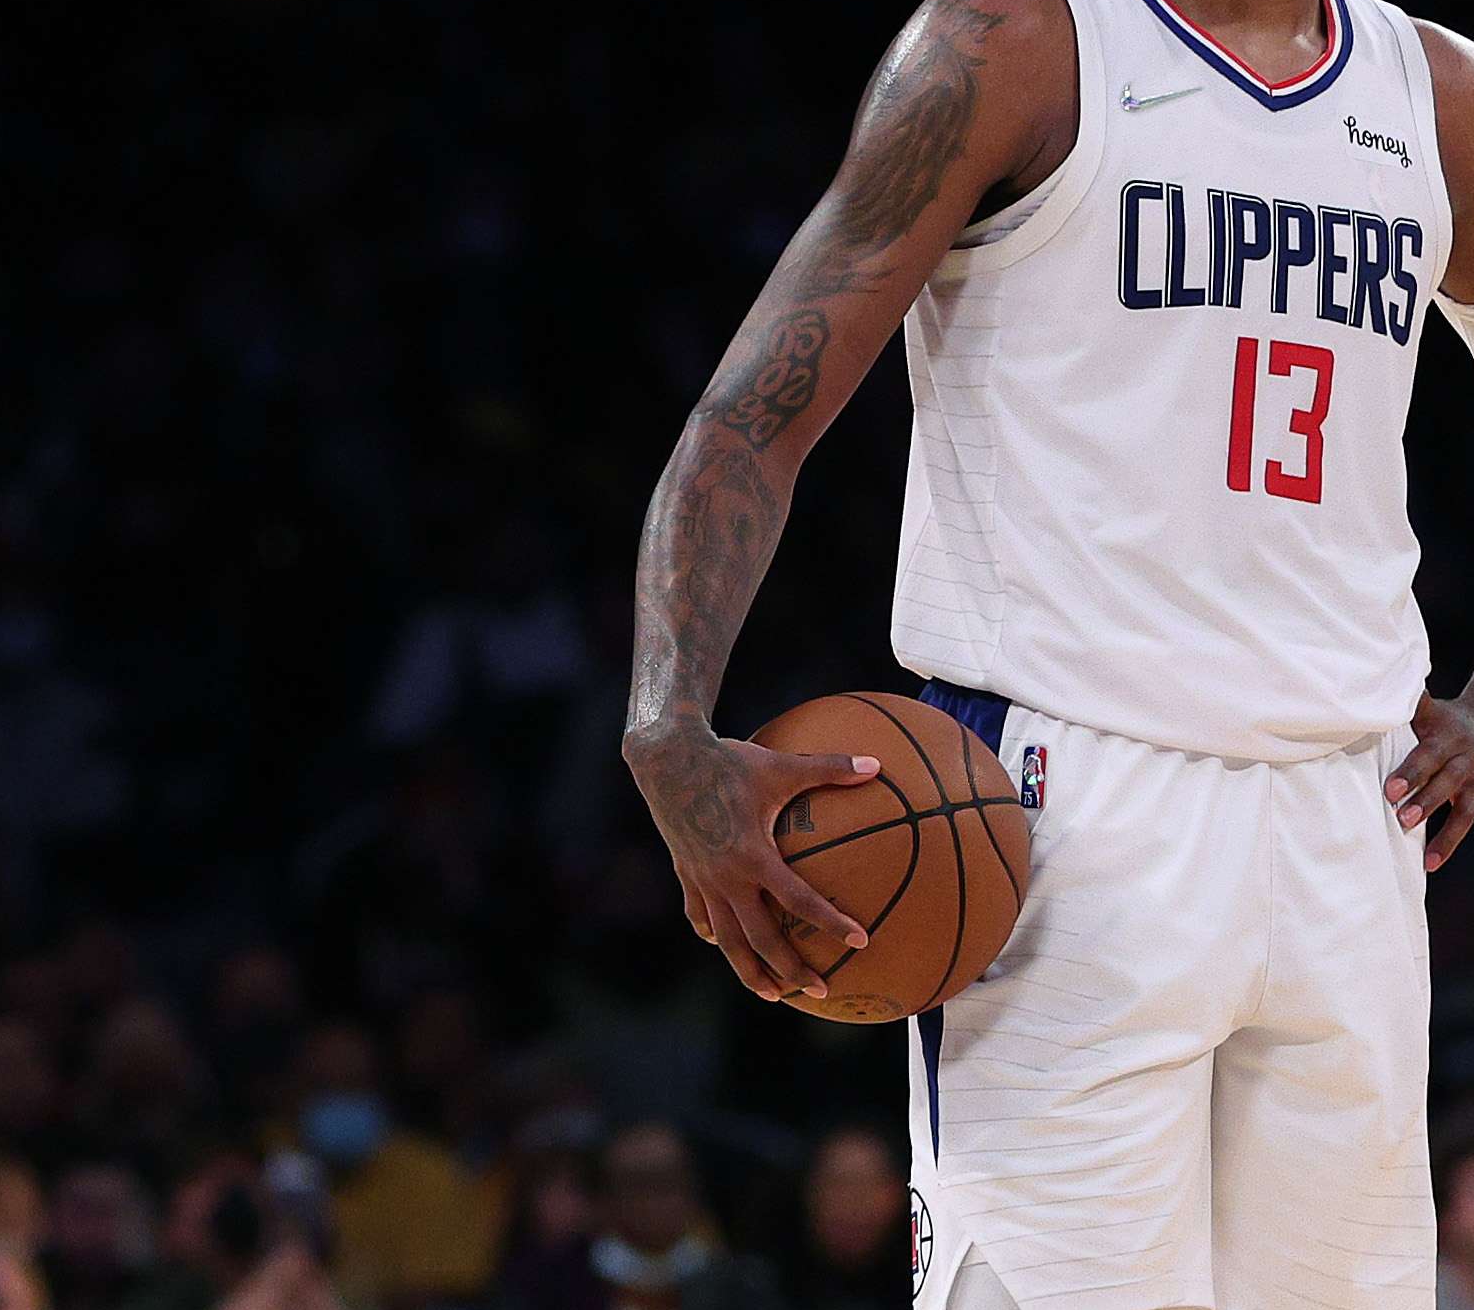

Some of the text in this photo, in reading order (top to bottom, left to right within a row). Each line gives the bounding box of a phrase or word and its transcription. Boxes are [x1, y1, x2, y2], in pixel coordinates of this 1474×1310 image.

[1343, 115, 1413, 169] honey
[1117, 179, 1422, 346] CLIPPERS
[1227, 336, 1334, 504] 13
